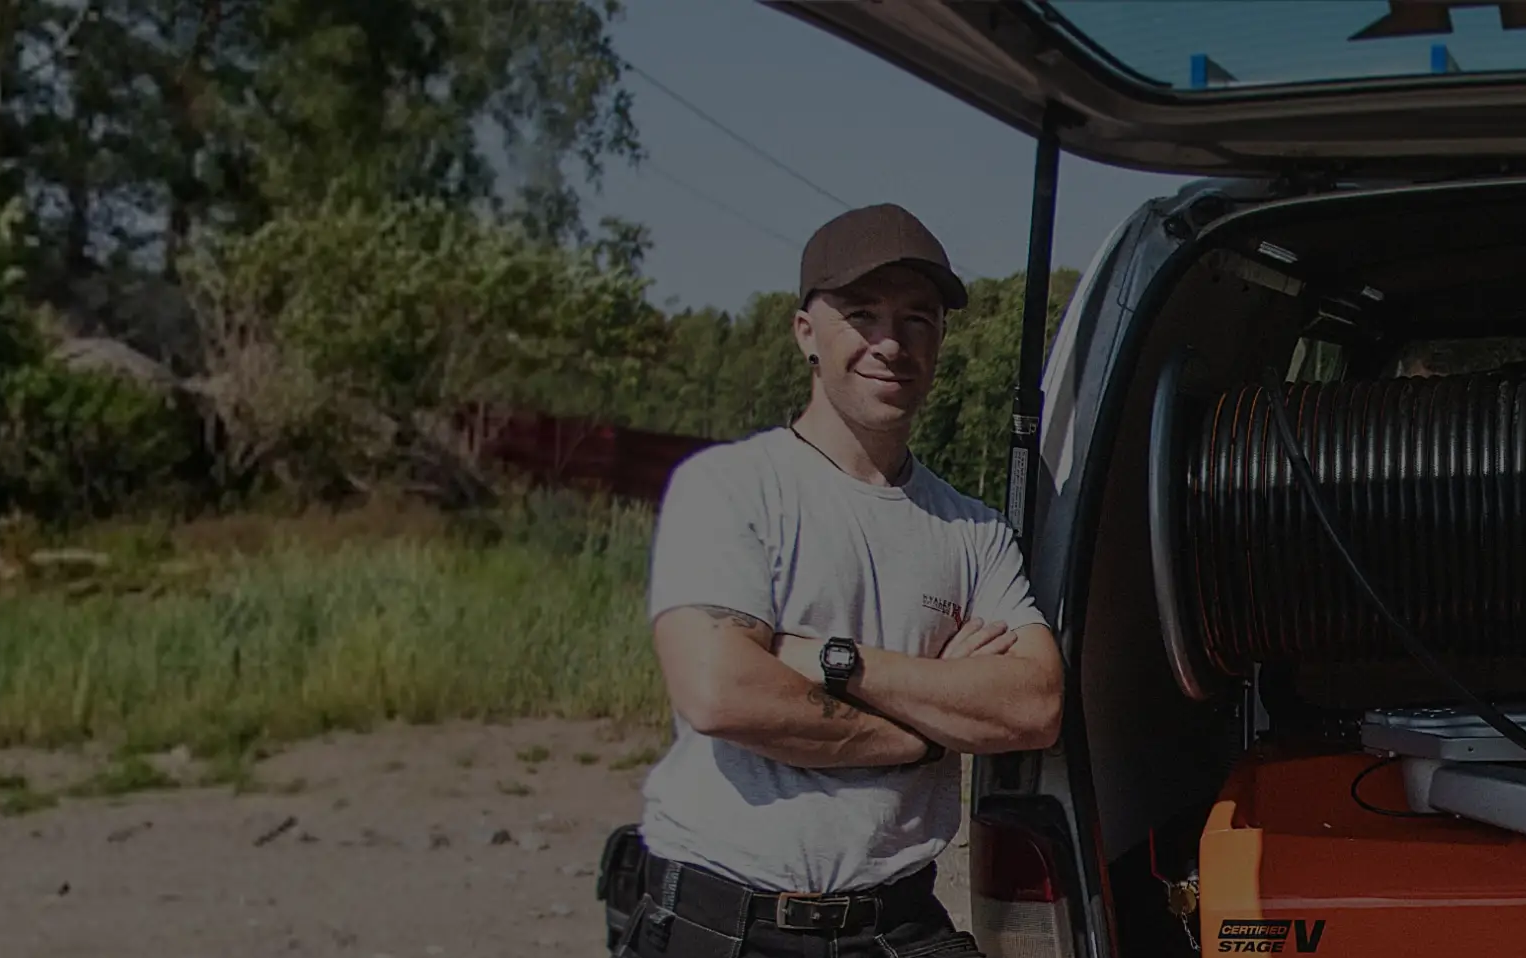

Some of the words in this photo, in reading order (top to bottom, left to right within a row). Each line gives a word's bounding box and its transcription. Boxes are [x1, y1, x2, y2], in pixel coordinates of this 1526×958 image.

[1217, 940, 1285, 953] STAGE
[1294, 919, 1326, 953] V
[1221, 925, 1287, 936] CERTIFIED
